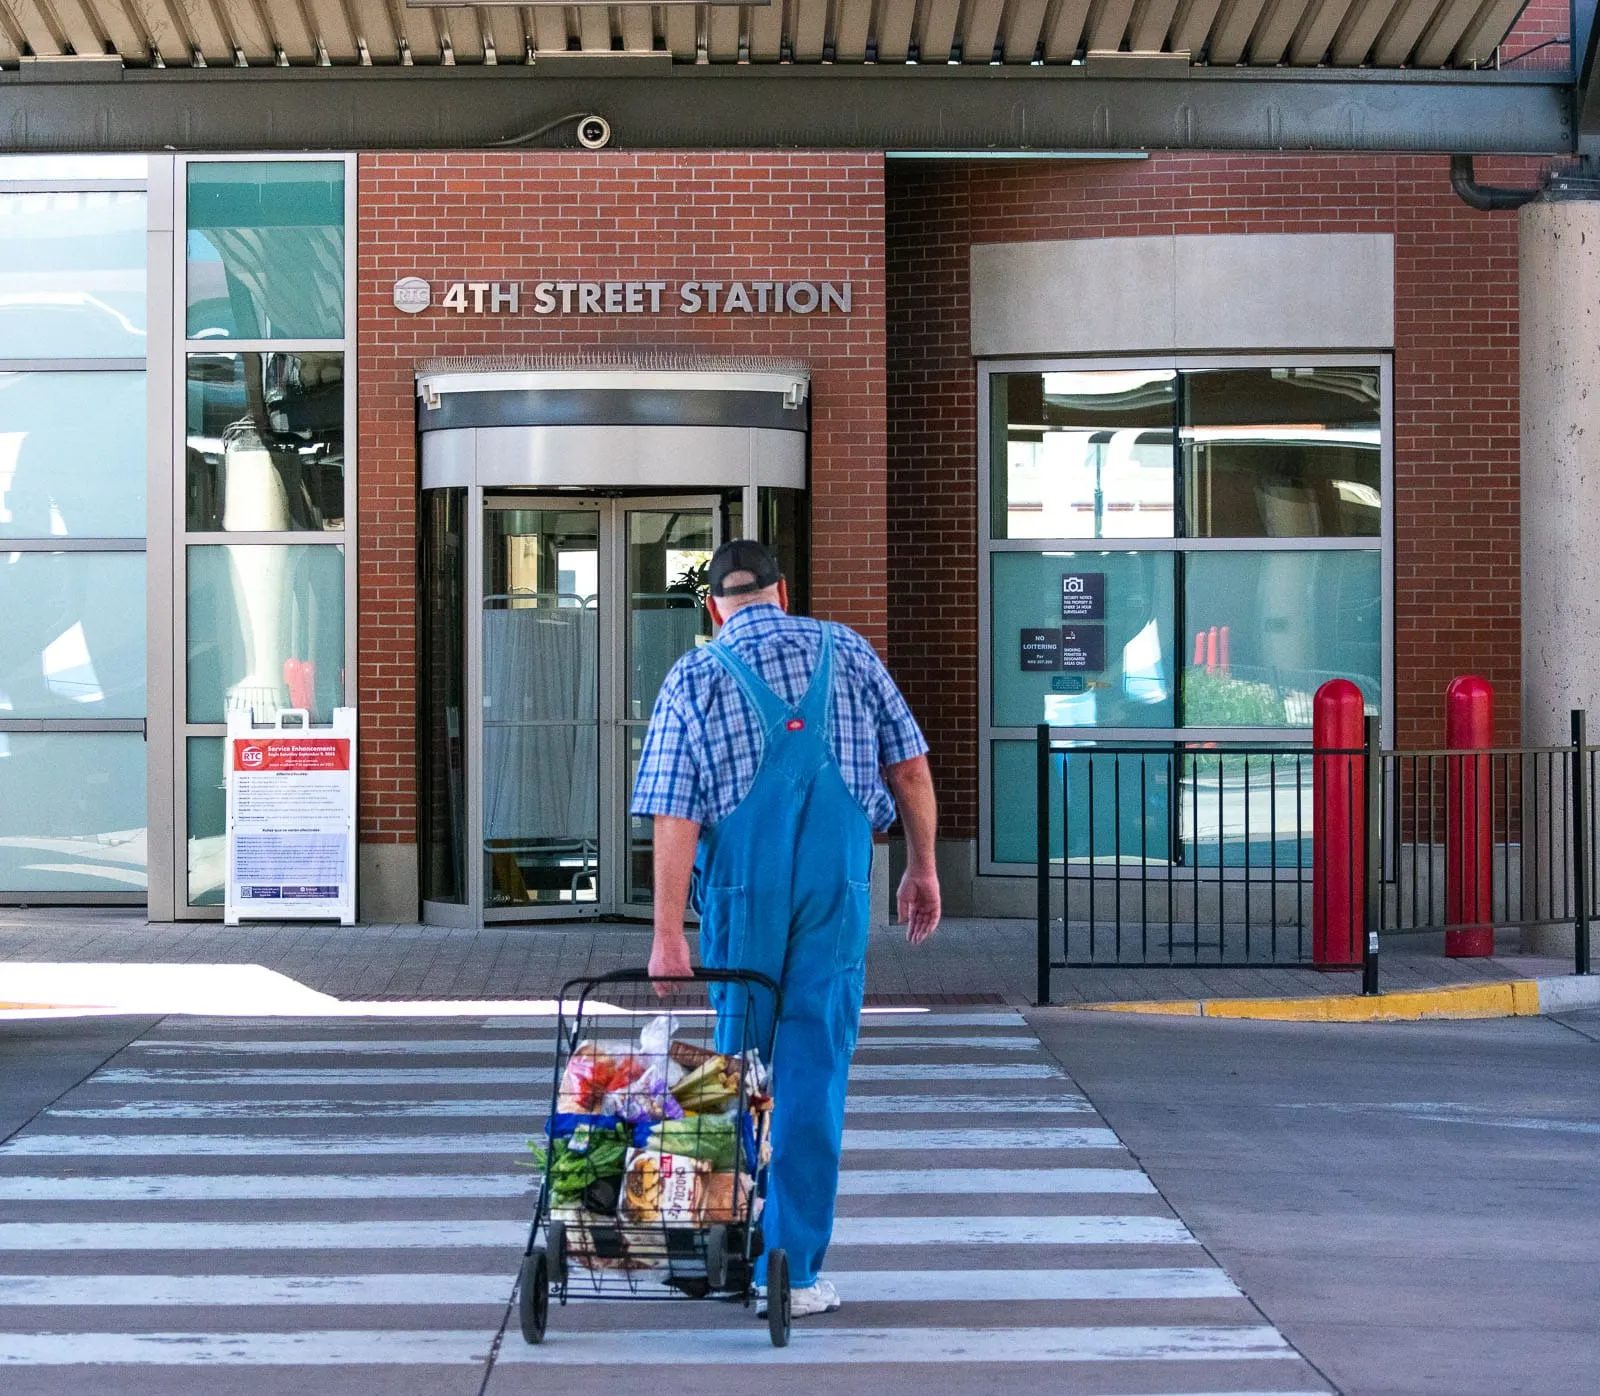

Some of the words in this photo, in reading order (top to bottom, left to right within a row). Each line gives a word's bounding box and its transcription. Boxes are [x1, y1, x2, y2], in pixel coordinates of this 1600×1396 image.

[396, 288, 429, 302] RTC
[442, 282, 518, 313] 4TH
[534, 282, 666, 314] STREET
[679, 281, 852, 314] STATION
[243, 752, 262, 760] RTC
